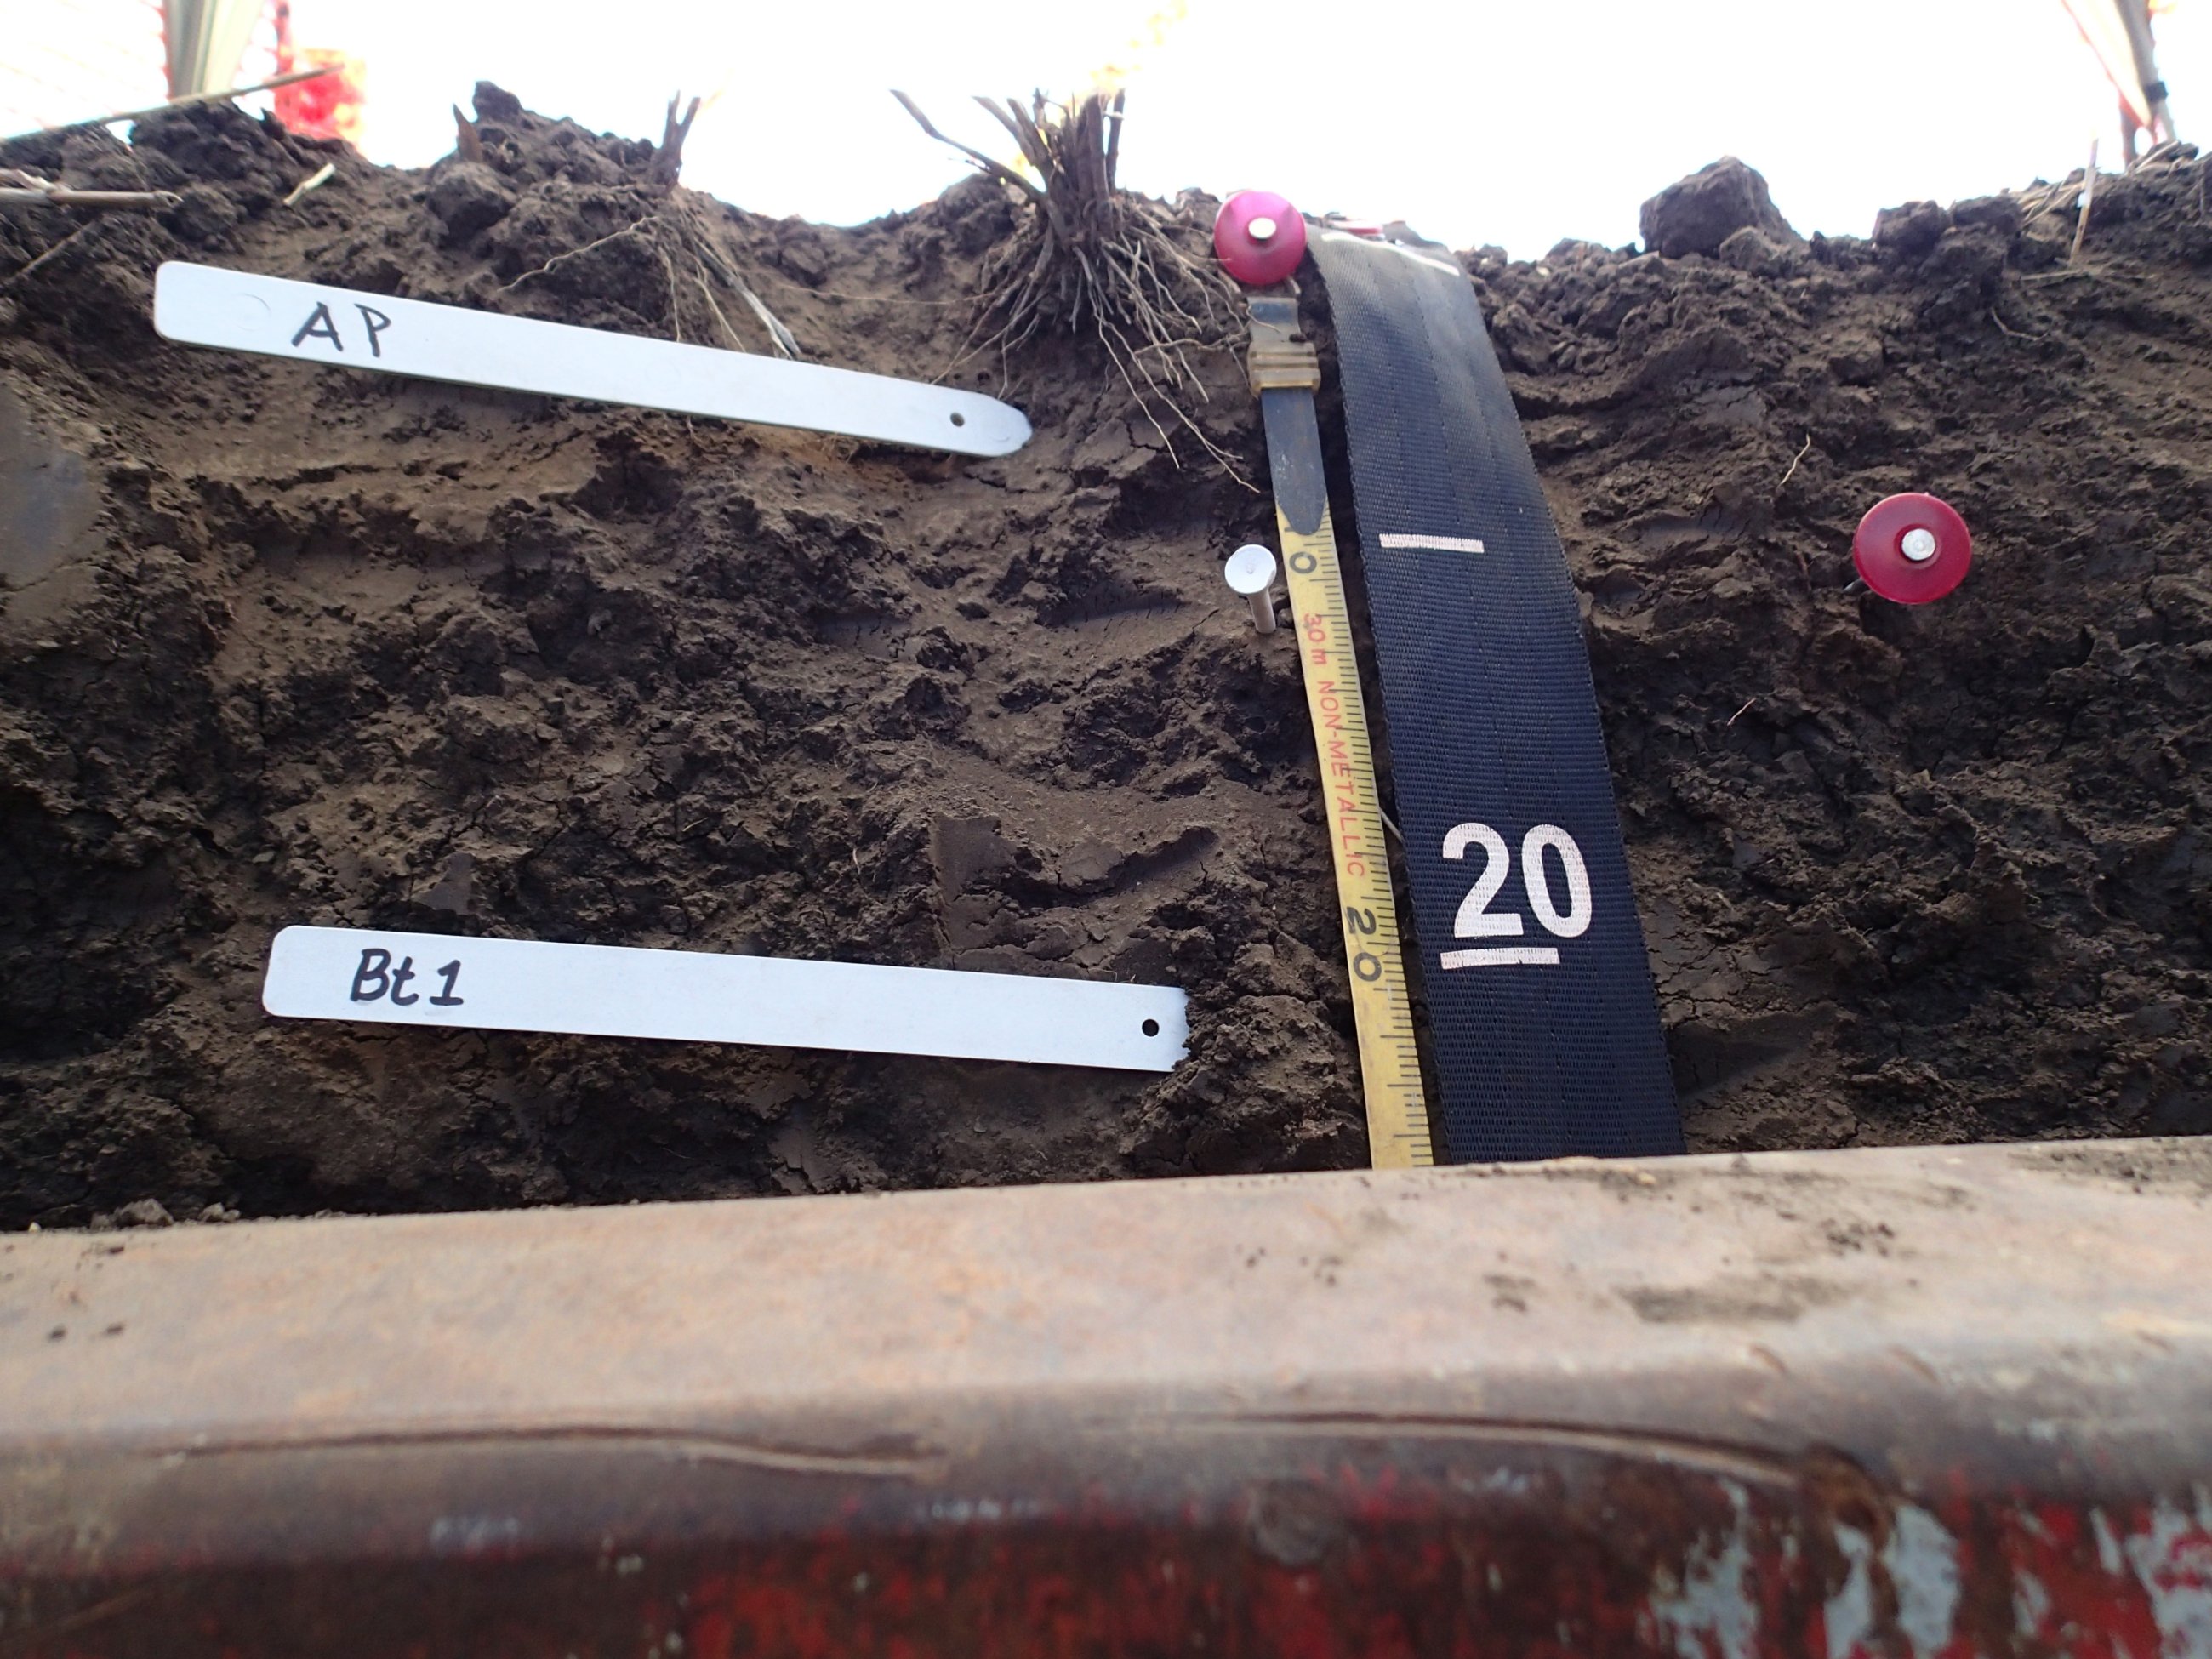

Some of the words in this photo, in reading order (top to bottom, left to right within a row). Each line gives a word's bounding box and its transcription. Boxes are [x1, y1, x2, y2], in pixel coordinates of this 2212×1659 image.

[291, 301, 391, 357] AP
[1318, 681, 1365, 877] NON-METALLIC
[1442, 822, 1592, 938] 20
[350, 948, 464, 1006] Bt1
[1347, 905, 1382, 982] 20
